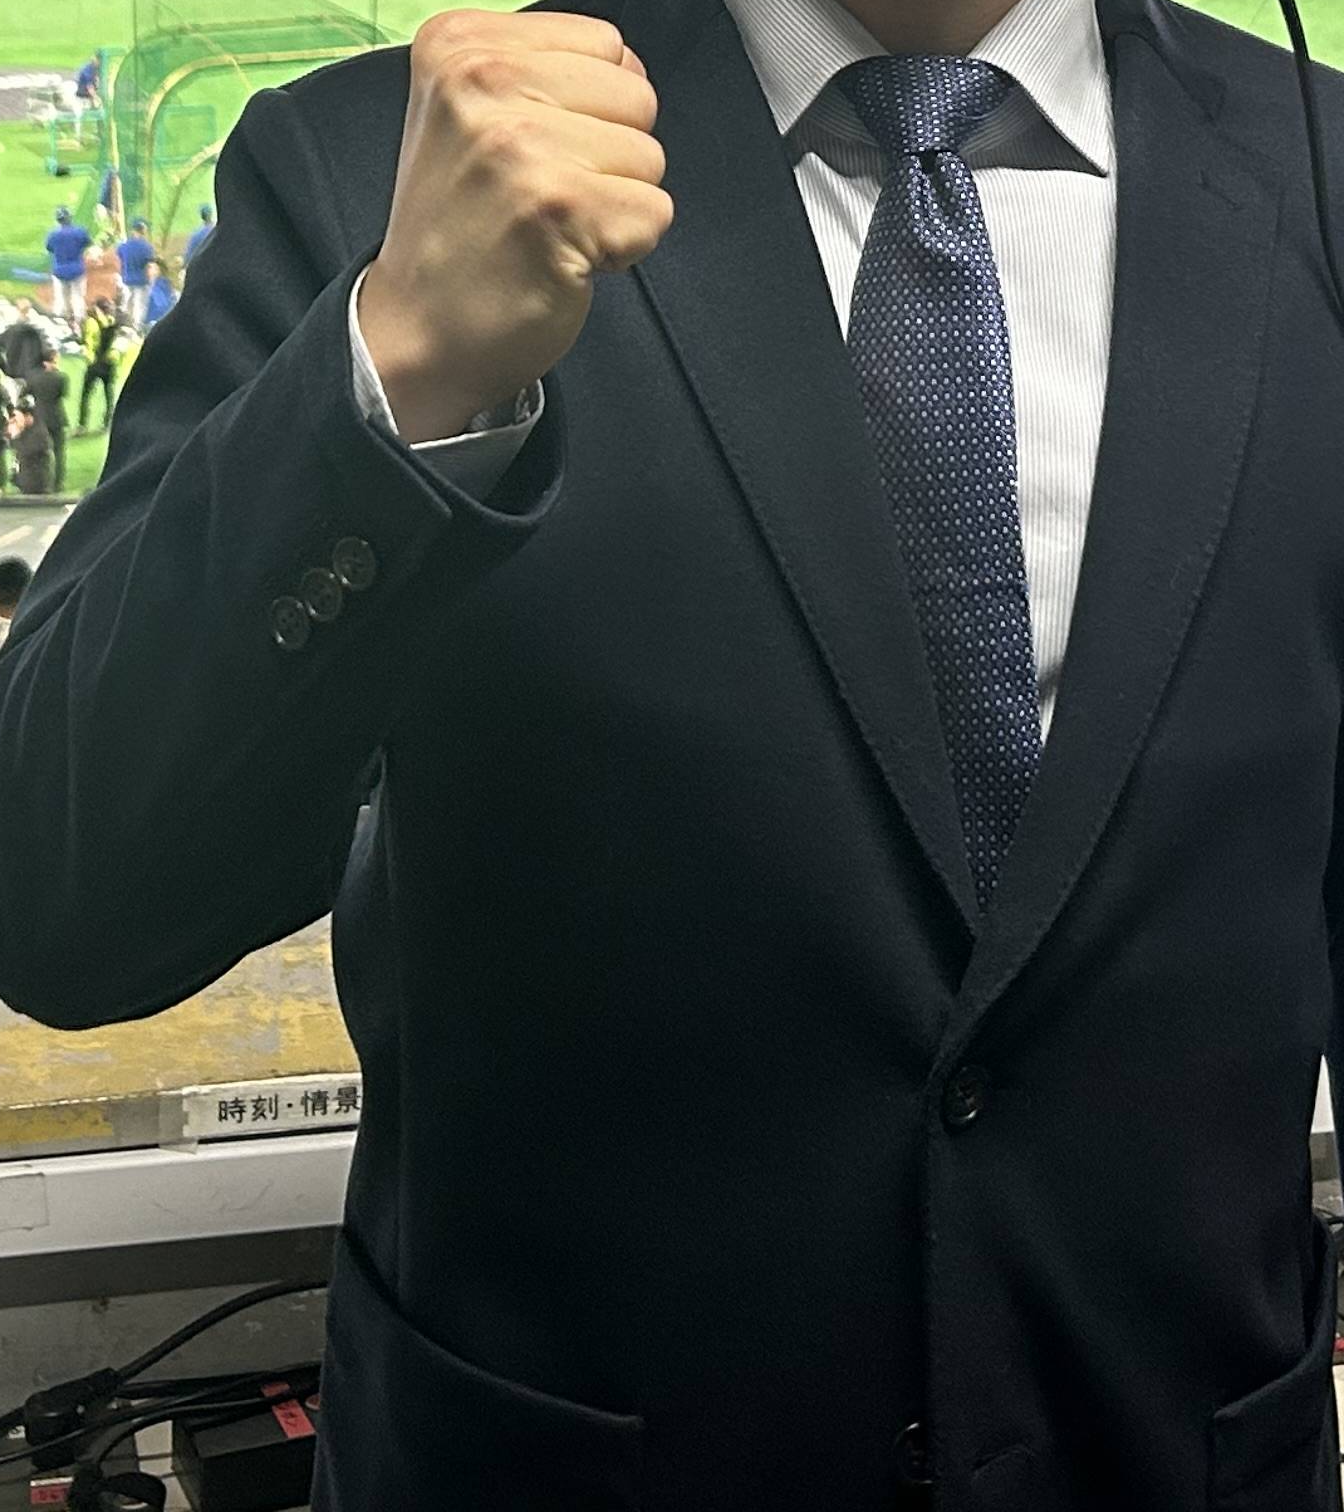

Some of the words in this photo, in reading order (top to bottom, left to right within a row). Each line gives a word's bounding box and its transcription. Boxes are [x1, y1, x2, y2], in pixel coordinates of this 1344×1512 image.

[218, 1086, 361, 1124] 時刻・情景
